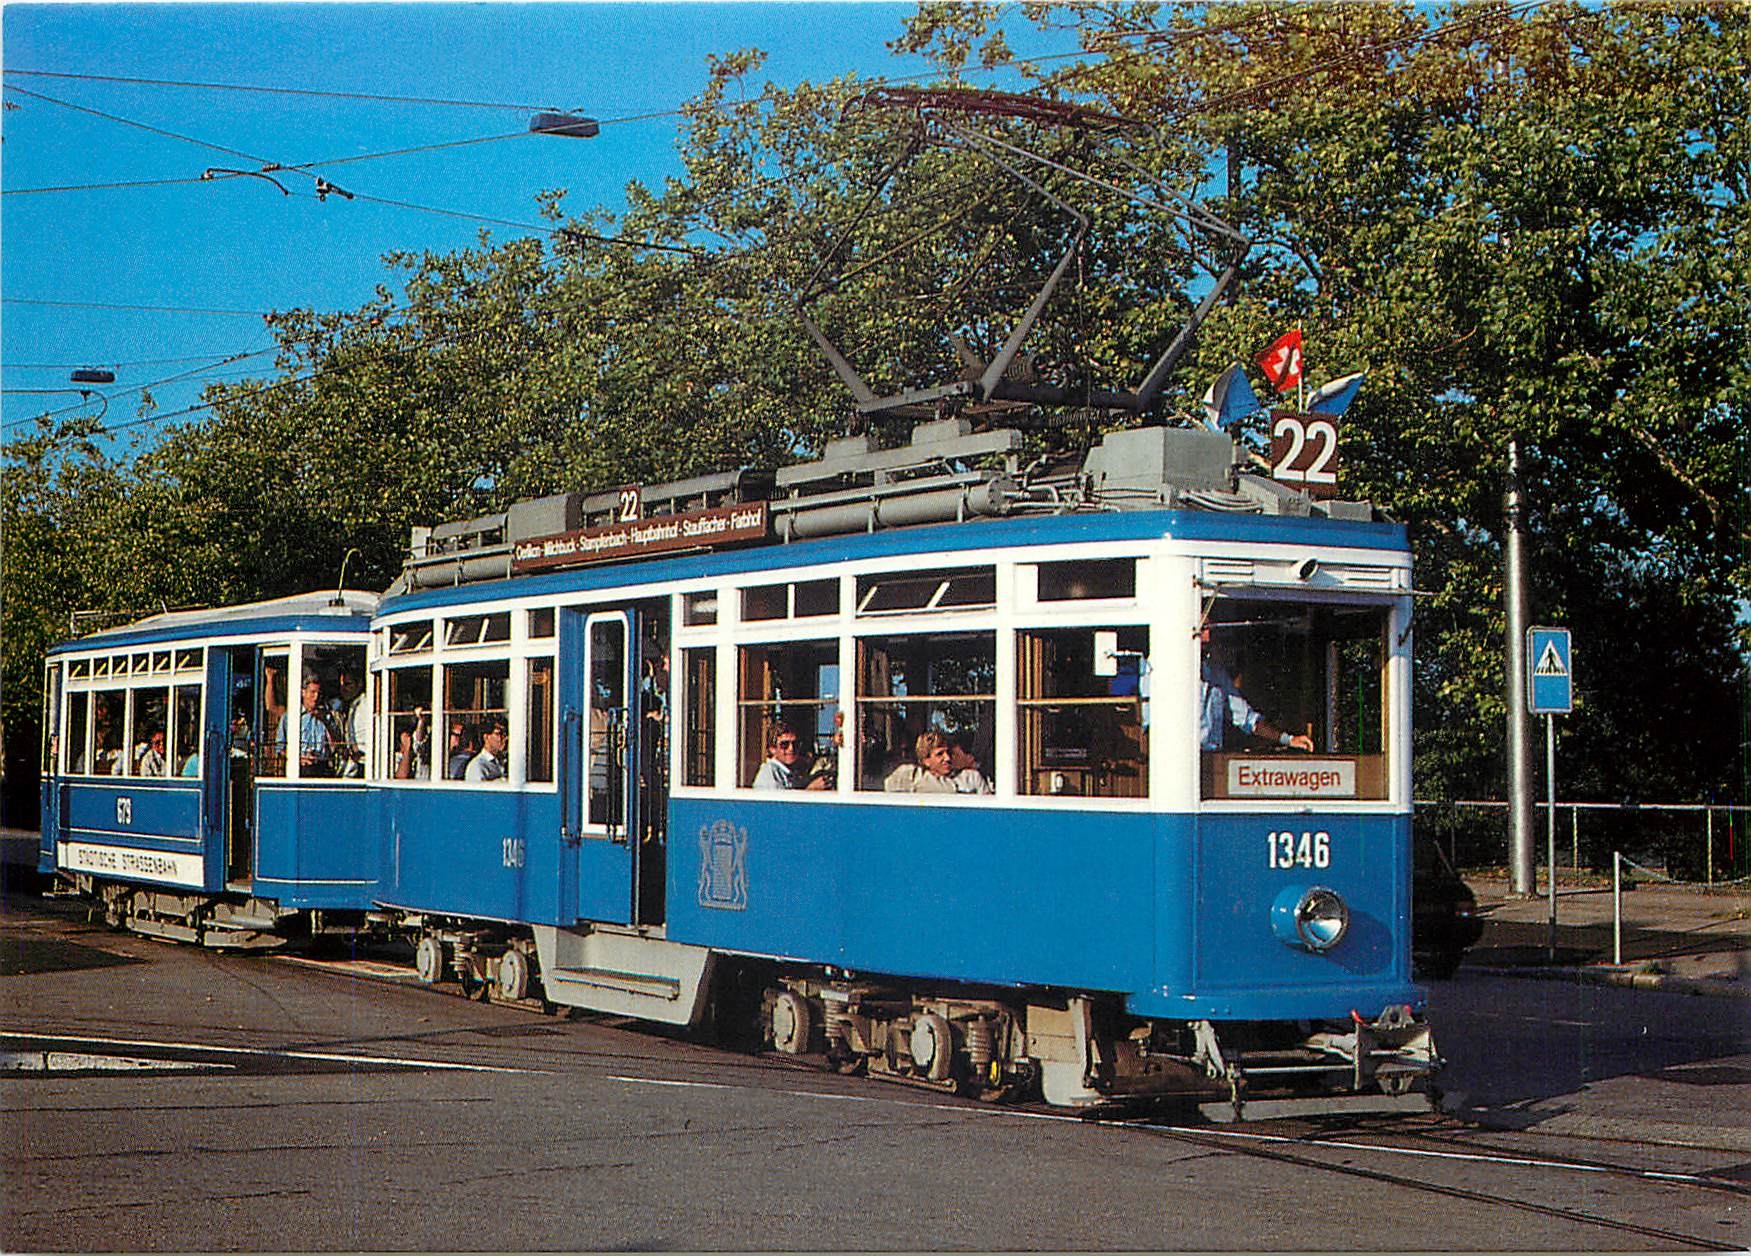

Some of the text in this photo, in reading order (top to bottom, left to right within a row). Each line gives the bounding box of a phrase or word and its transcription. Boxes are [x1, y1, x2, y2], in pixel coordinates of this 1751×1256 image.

[1273, 418, 1336, 483] 22
[619, 490, 638, 523] 22
[682, 516, 727, 536] Stauffacher
[1238, 766, 1341, 791] Extrawagen
[502, 837, 525, 868] 1346
[1267, 831, 1330, 869] 1346
